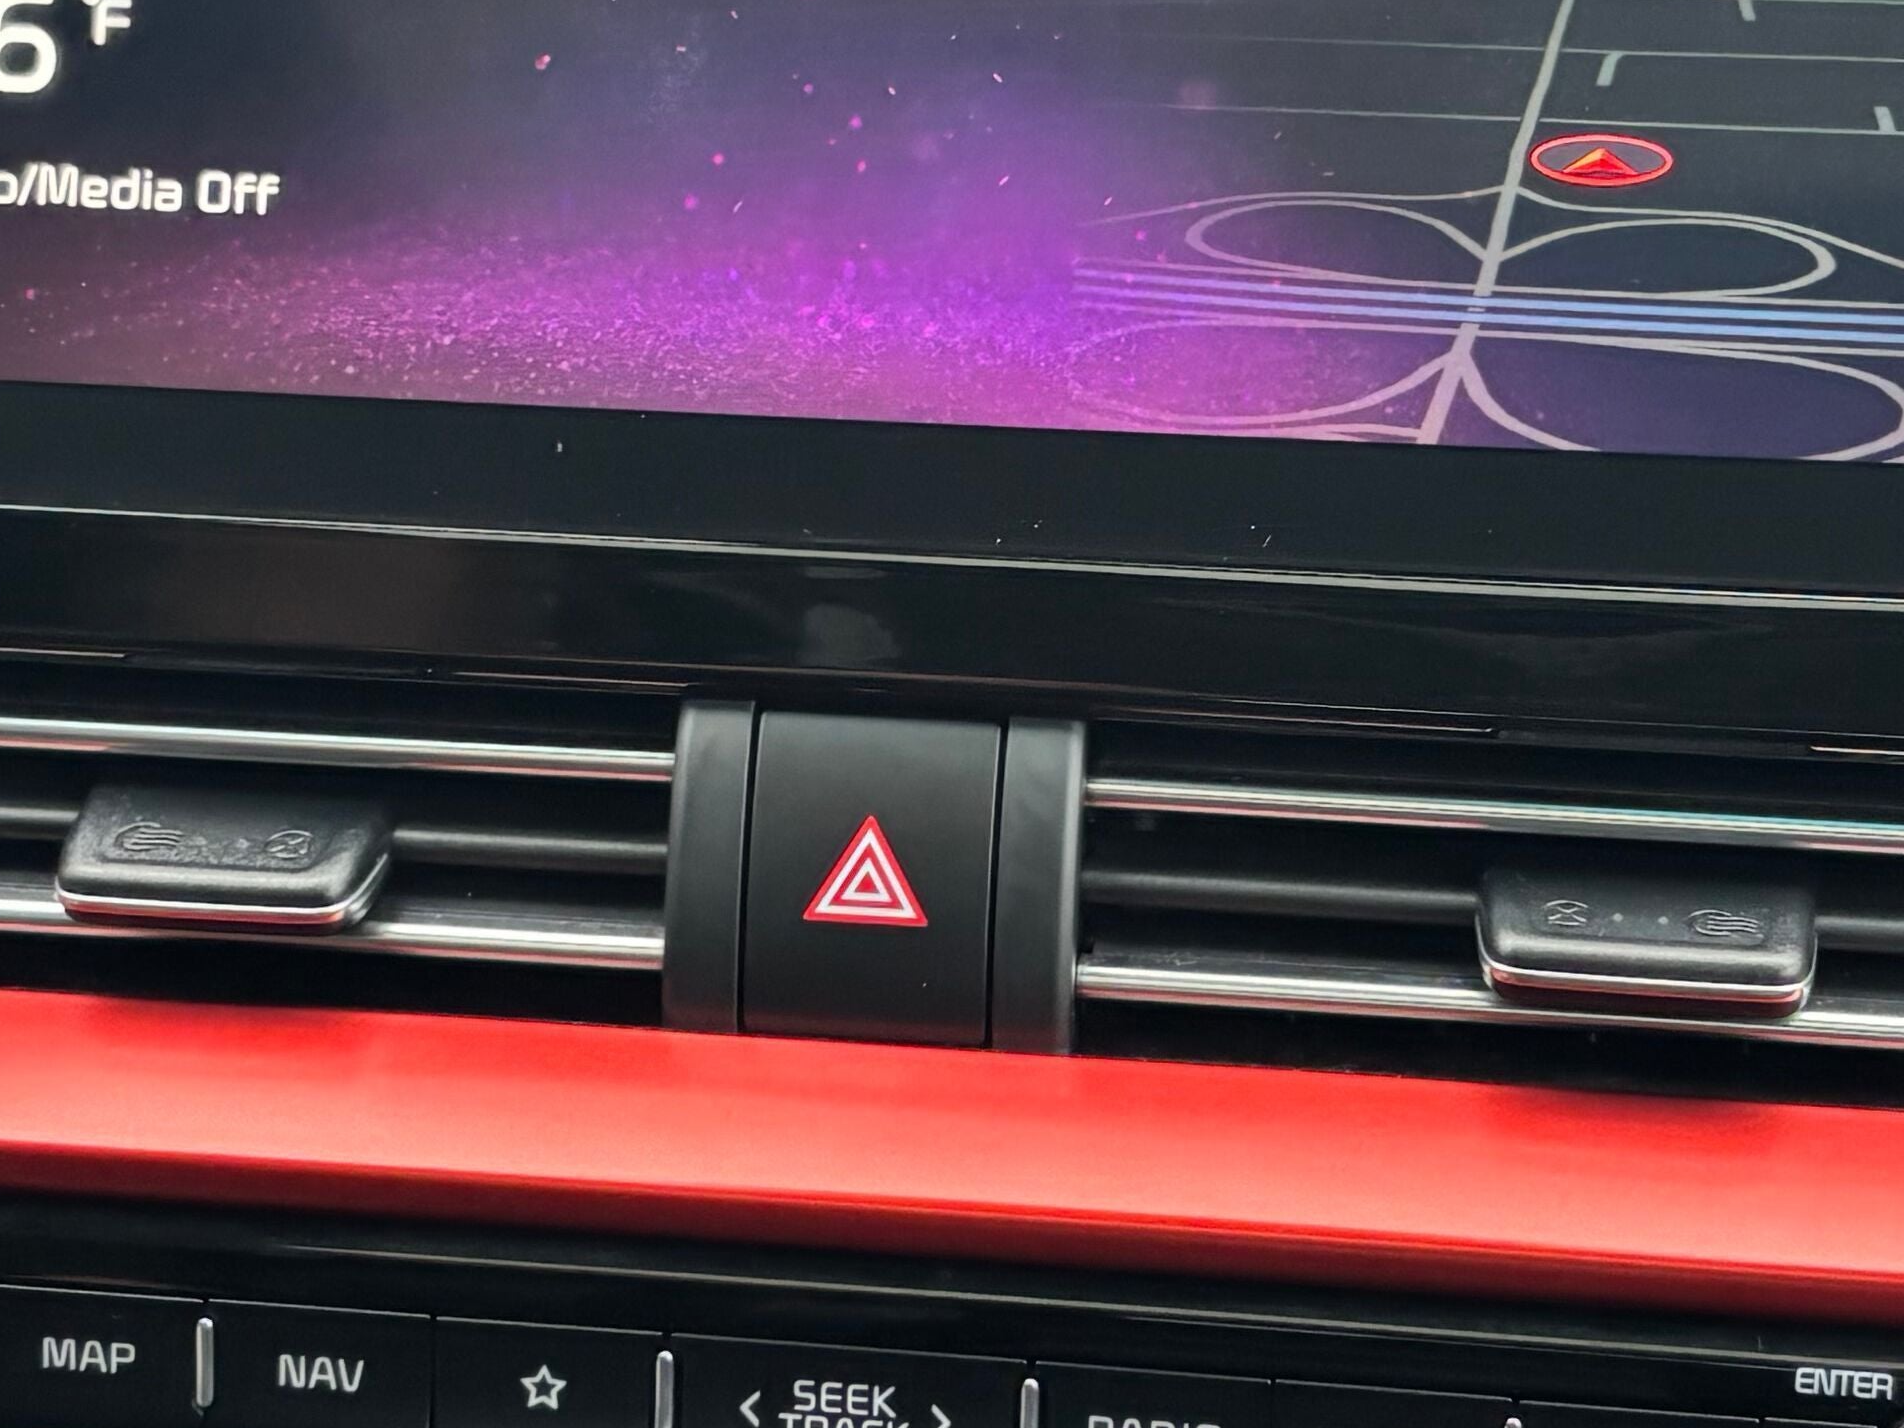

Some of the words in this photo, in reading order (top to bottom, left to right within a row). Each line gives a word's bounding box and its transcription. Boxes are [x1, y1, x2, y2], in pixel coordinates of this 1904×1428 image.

[198, 171, 280, 215] Off
[43, 1337, 135, 1373] MAP
[279, 1354, 363, 1392] NAV
[793, 1380, 897, 1417] SEEK
[1795, 1367, 1894, 1401] ENTER
